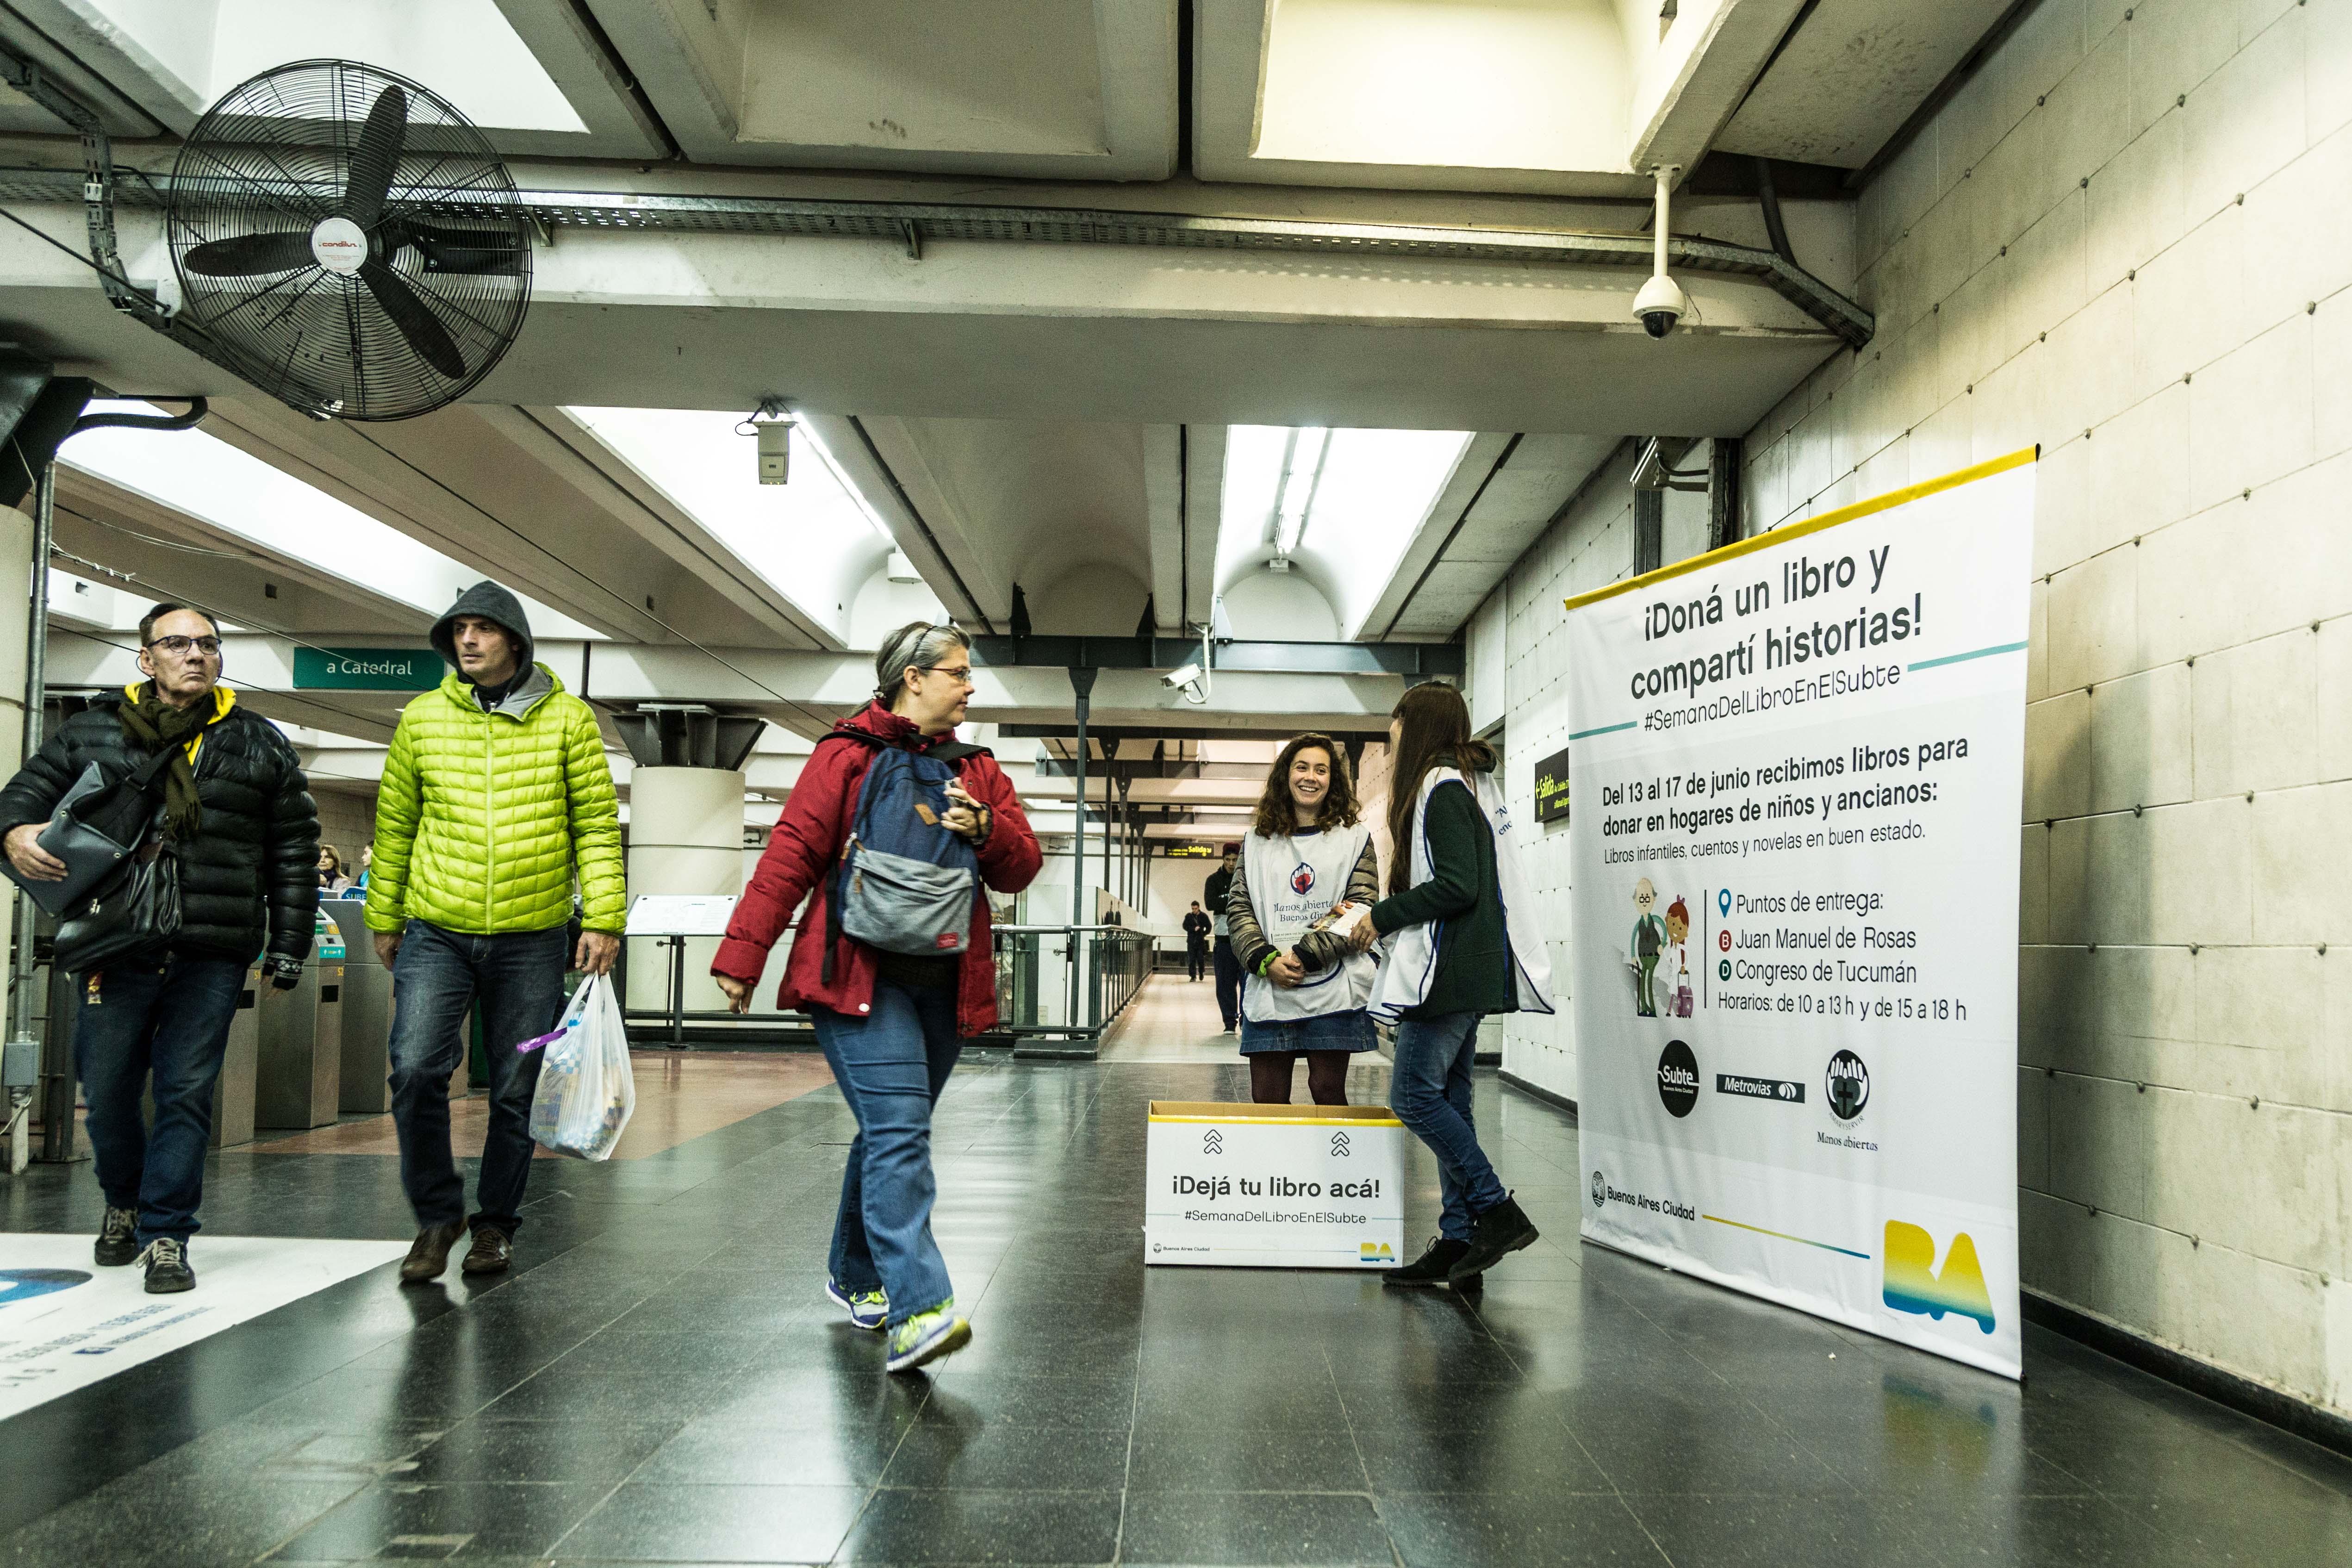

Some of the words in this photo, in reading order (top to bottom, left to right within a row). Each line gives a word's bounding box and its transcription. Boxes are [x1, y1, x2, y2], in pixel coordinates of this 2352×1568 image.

[1646, 584, 1723, 641] ¡Doná
[1736, 581, 1769, 616] un
[1785, 556, 1855, 604] libro
[1870, 545, 1891, 593] y
[1631, 634, 1755, 699] compartí
[1767, 593, 1920, 670] historias!
[326, 664, 336, 673] a
[341, 660, 413, 675] Catedral
[1645, 663, 1900, 731] #SemanaDelLibroEnElSubte
[1603, 783, 1623, 806] Del
[1629, 782, 1643, 803] 13
[1648, 778, 1660, 800] al
[1666, 776, 1681, 797] 17
[1686, 772, 1705, 795] de
[1711, 767, 1749, 798] junio
[1757, 757, 1844, 785] recibimos
[1853, 746, 1909, 772] libros
[1919, 739, 1967, 771] para
[1540, 773, 1554, 799] Salida
[1604, 815, 1642, 836] donar
[1647, 815, 1664, 832] en
[1670, 807, 1733, 834] hogares
[1739, 803, 1761, 822] de
[1768, 794, 1814, 819] niños
[1822, 795, 1831, 821] y
[1838, 783, 1936, 810] ancianos:
[1605, 848, 1634, 864] Libros
[1638, 842, 1686, 861] infantiles,
[1692, 840, 1738, 857] cuentos
[1742, 840, 1748, 858] y
[1754, 832, 1801, 852] novelas
[1807, 834, 1823, 847] en
[1829, 828, 1863, 845] buen
[1871, 820, 1925, 842] estado.
[1302, 900, 1333, 910] abierta
[1736, 892, 1785, 914] Puntos
[1791, 890, 1810, 912] de
[1816, 892, 1883, 916] entrega:
[1736, 929, 1770, 948] Juan
[1777, 927, 1830, 948] Manuel
[1836, 926, 1856, 948] de
[1864, 927, 1916, 948] Rosas
[1736, 959, 1807, 986] Congreso
[1813, 959, 1832, 981] de
[1837, 960, 1916, 983] Tucumán
[1719, 992, 1772, 1011] Horarios:
[1777, 993, 1794, 1012] de
[1798, 995, 1811, 1013] 10
[1817, 1000, 1824, 1014] a
[1829, 996, 1841, 1014] 13
[1846, 995, 1853, 1014] h
[1860, 1002, 1869, 1021] y
[1875, 996, 1892, 1017] de
[1898, 999, 1912, 1018] 15
[1918, 1004, 1926, 1019] a
[1933, 999, 1948, 1020] 18
[1956, 999, 1966, 1020] h
[1662, 1065, 1695, 1085] Subte
[1724, 1077, 1772, 1097] Metrovías
[1817, 1132, 1842, 1146] Manos
[1843, 1136, 1878, 1151] abiertas
[1174, 1176, 1230, 1201] ¡Dejá
[1240, 1178, 1261, 1195] tu
[1270, 1177, 1321, 1197] libro
[1330, 1179, 1379, 1198] acá!
[1185, 1210, 1366, 1223] #SemanaDelLibroEnElSubte
[1608, 1186, 1636, 1206] Buenos
[1637, 1194, 1660, 1212] Aires
[1663, 1200, 1694, 1221] Ciudad
[1360, 1242, 1395, 1262] BA
[1883, 1220, 1996, 1335] BA
